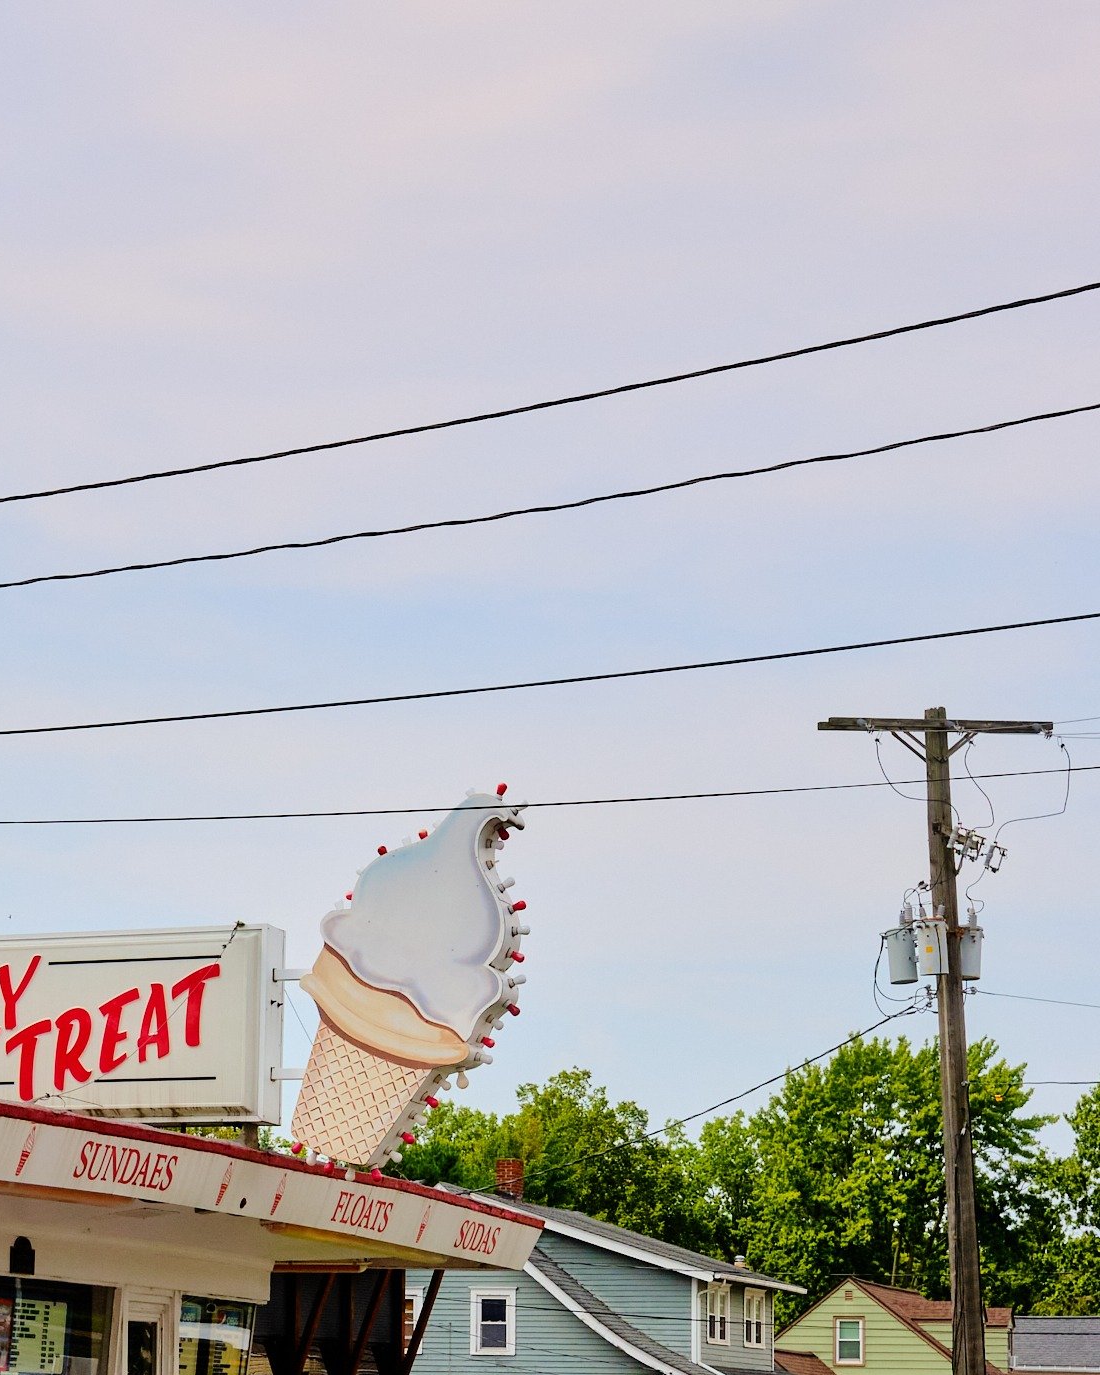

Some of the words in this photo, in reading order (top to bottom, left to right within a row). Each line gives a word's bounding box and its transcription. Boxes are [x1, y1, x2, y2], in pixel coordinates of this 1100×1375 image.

[5, 963, 221, 1101] TREAT
[73, 1140, 179, 1191] SUNDAES
[330, 1190, 394, 1234] FLOATS
[453, 1219, 501, 1256] SODAS
